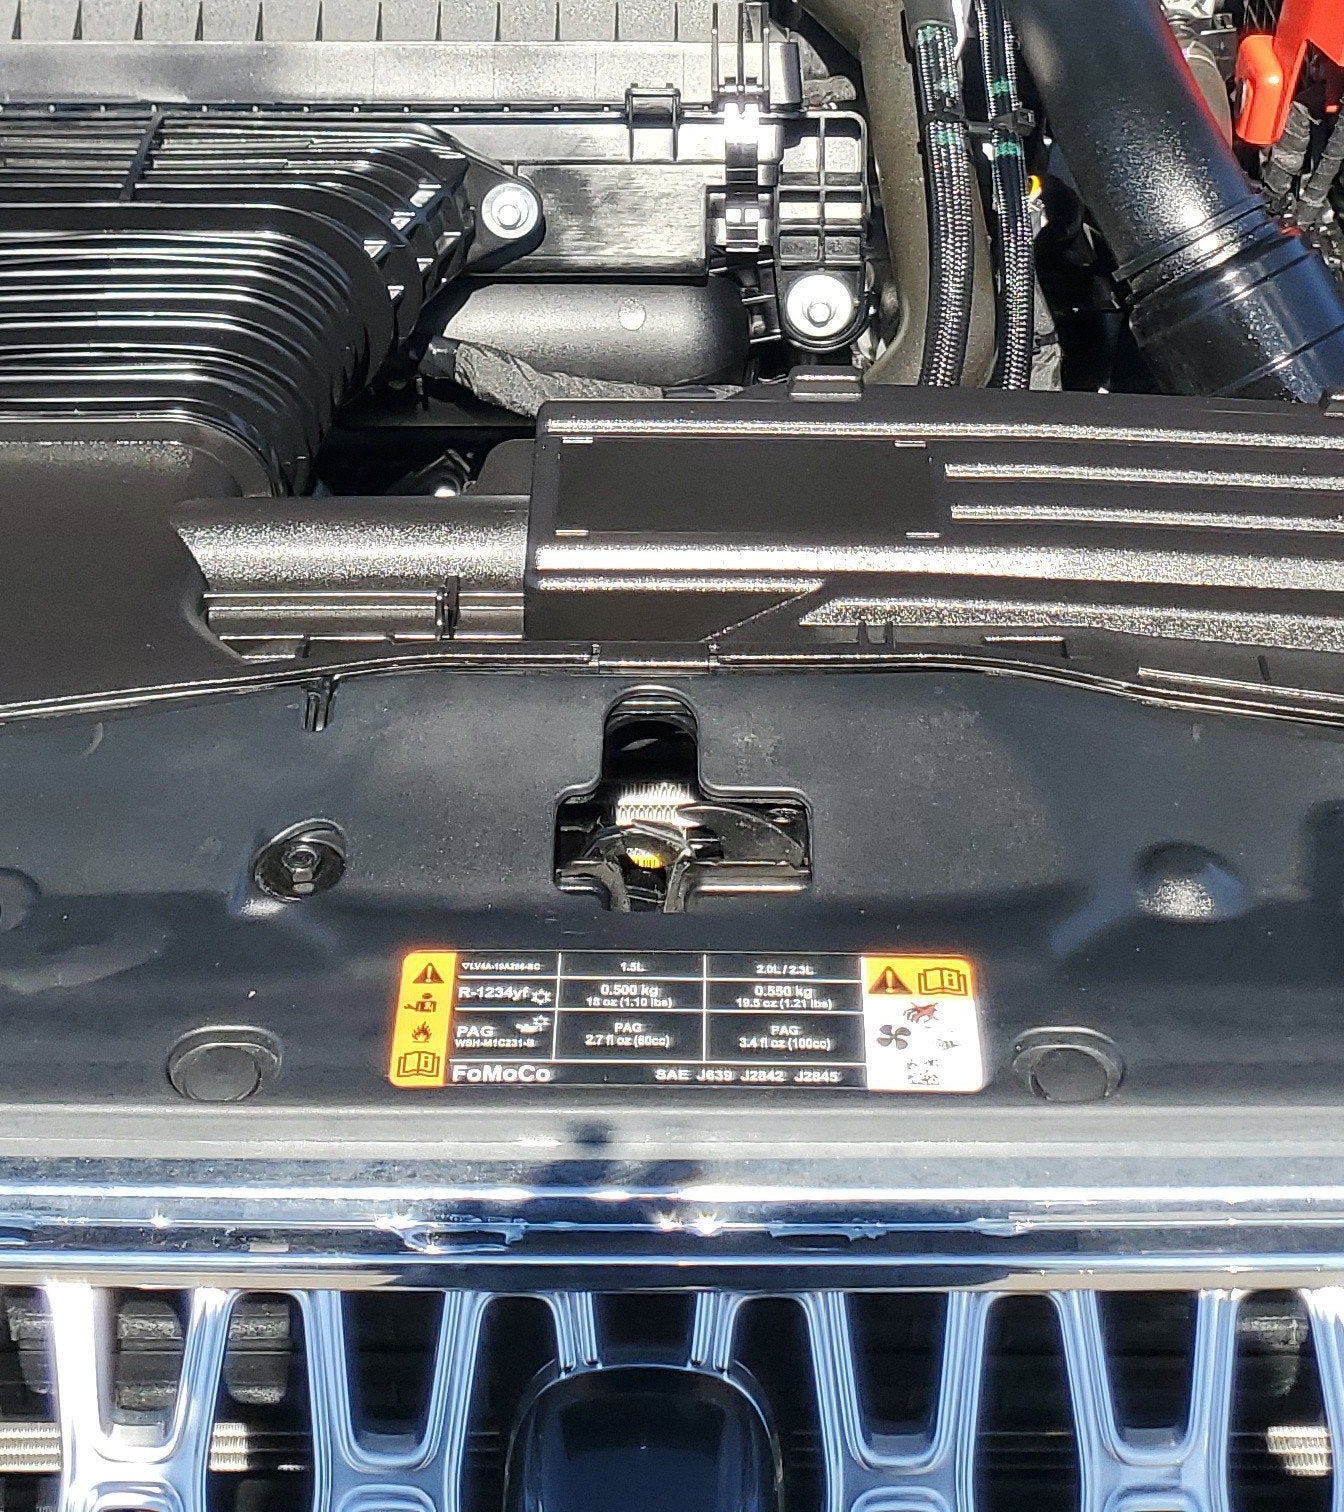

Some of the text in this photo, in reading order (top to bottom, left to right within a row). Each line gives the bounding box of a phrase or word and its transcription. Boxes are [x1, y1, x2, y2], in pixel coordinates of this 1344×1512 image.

[620, 961, 646, 973] 1.5L
[756, 964, 781, 975] 2.0L
[458, 985, 529, 1001] R-1234yf
[600, 984, 659, 998] 0.500 kg
[795, 985, 813, 999] kg
[602, 998, 618, 1007] oz
[762, 999, 778, 1008] oz
[456, 1025, 495, 1037] PAG
[614, 1022, 643, 1033] PAG
[770, 1025, 800, 1036] PAG
[584, 1034, 604, 1046] 2.7
[739, 1037, 758, 1048] 3.4
[452, 1064, 552, 1083] FoMoCo
[655, 1069, 691, 1081] SAE
[696, 1069, 734, 1082] J639
[740, 1070, 786, 1082] J2842
